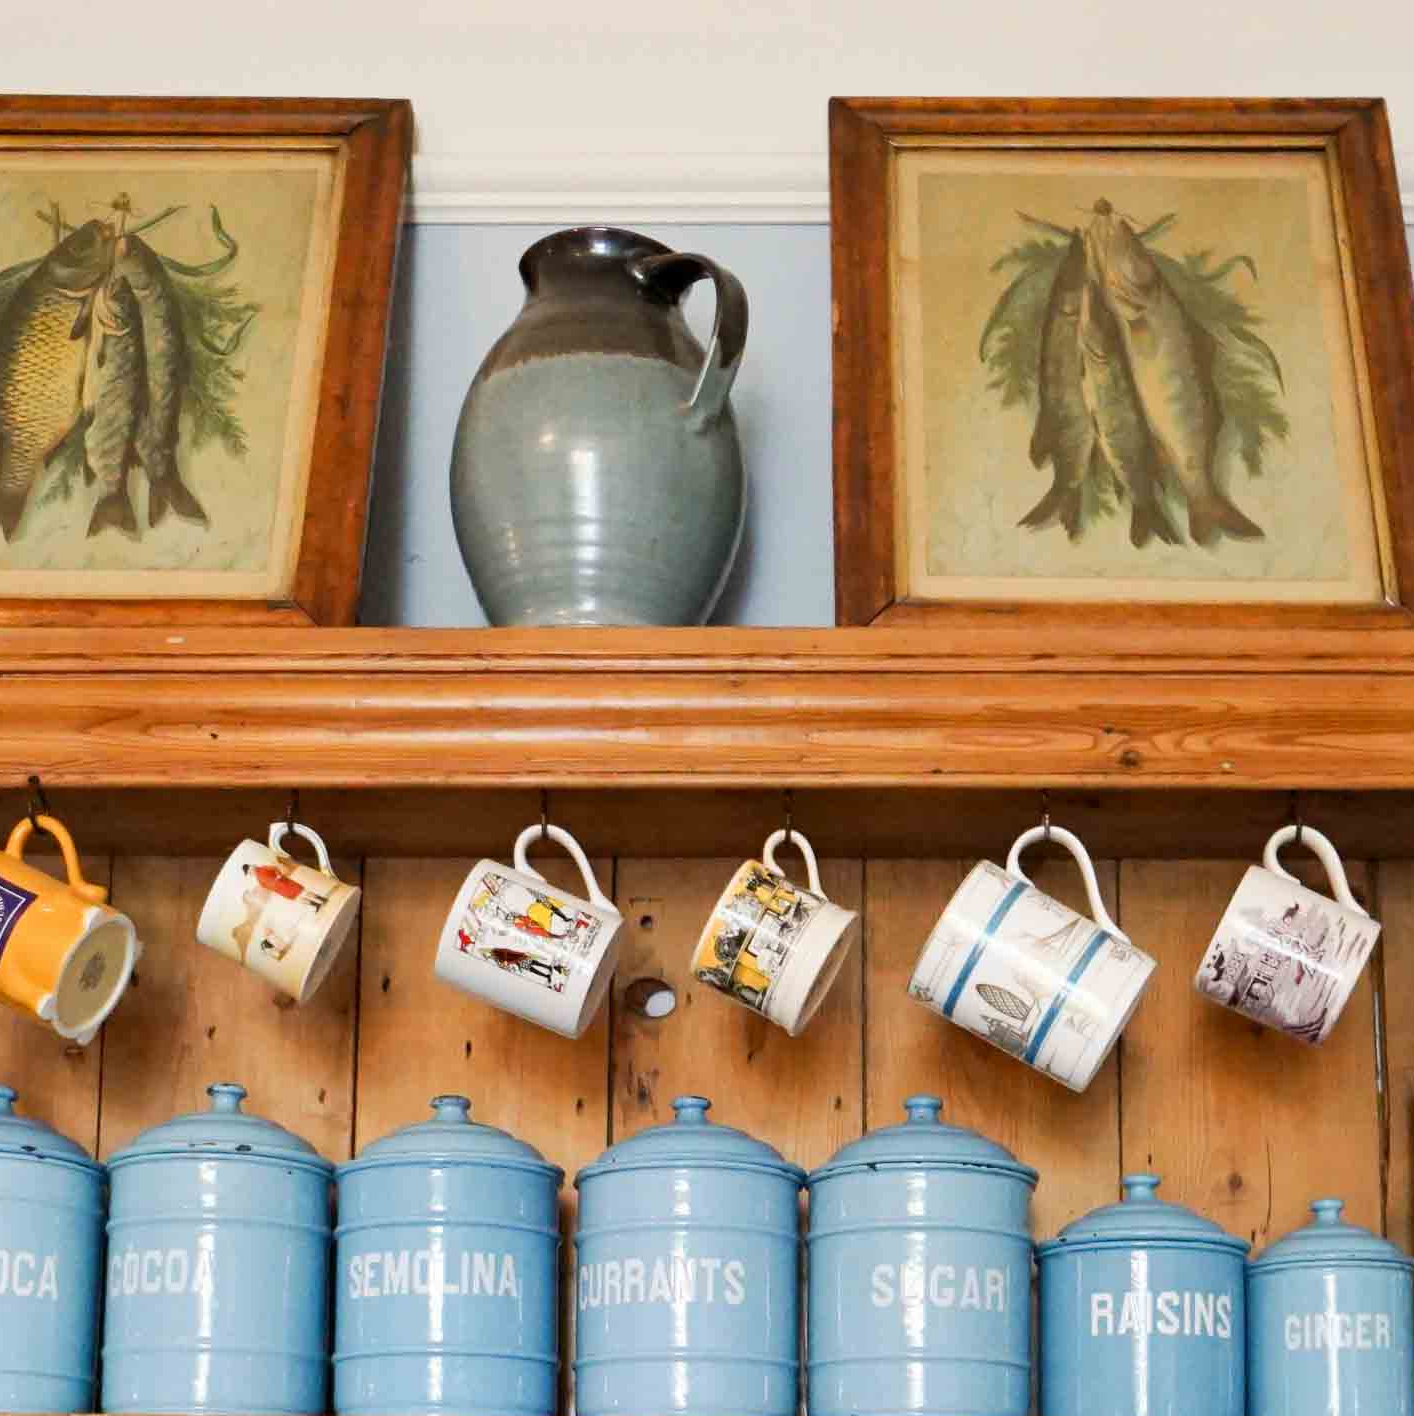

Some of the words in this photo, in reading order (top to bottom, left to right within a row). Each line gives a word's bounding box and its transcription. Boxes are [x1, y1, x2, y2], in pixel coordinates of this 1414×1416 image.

[106, 1247, 217, 1299] COCOA
[347, 1251, 519, 1300] SEMOLINA
[577, 1257, 746, 1312] CURRANTS
[870, 1262, 1006, 1312] SUGAR
[1090, 1289, 1234, 1340] RAISINS
[1284, 1311, 1392, 1352] GINGER
